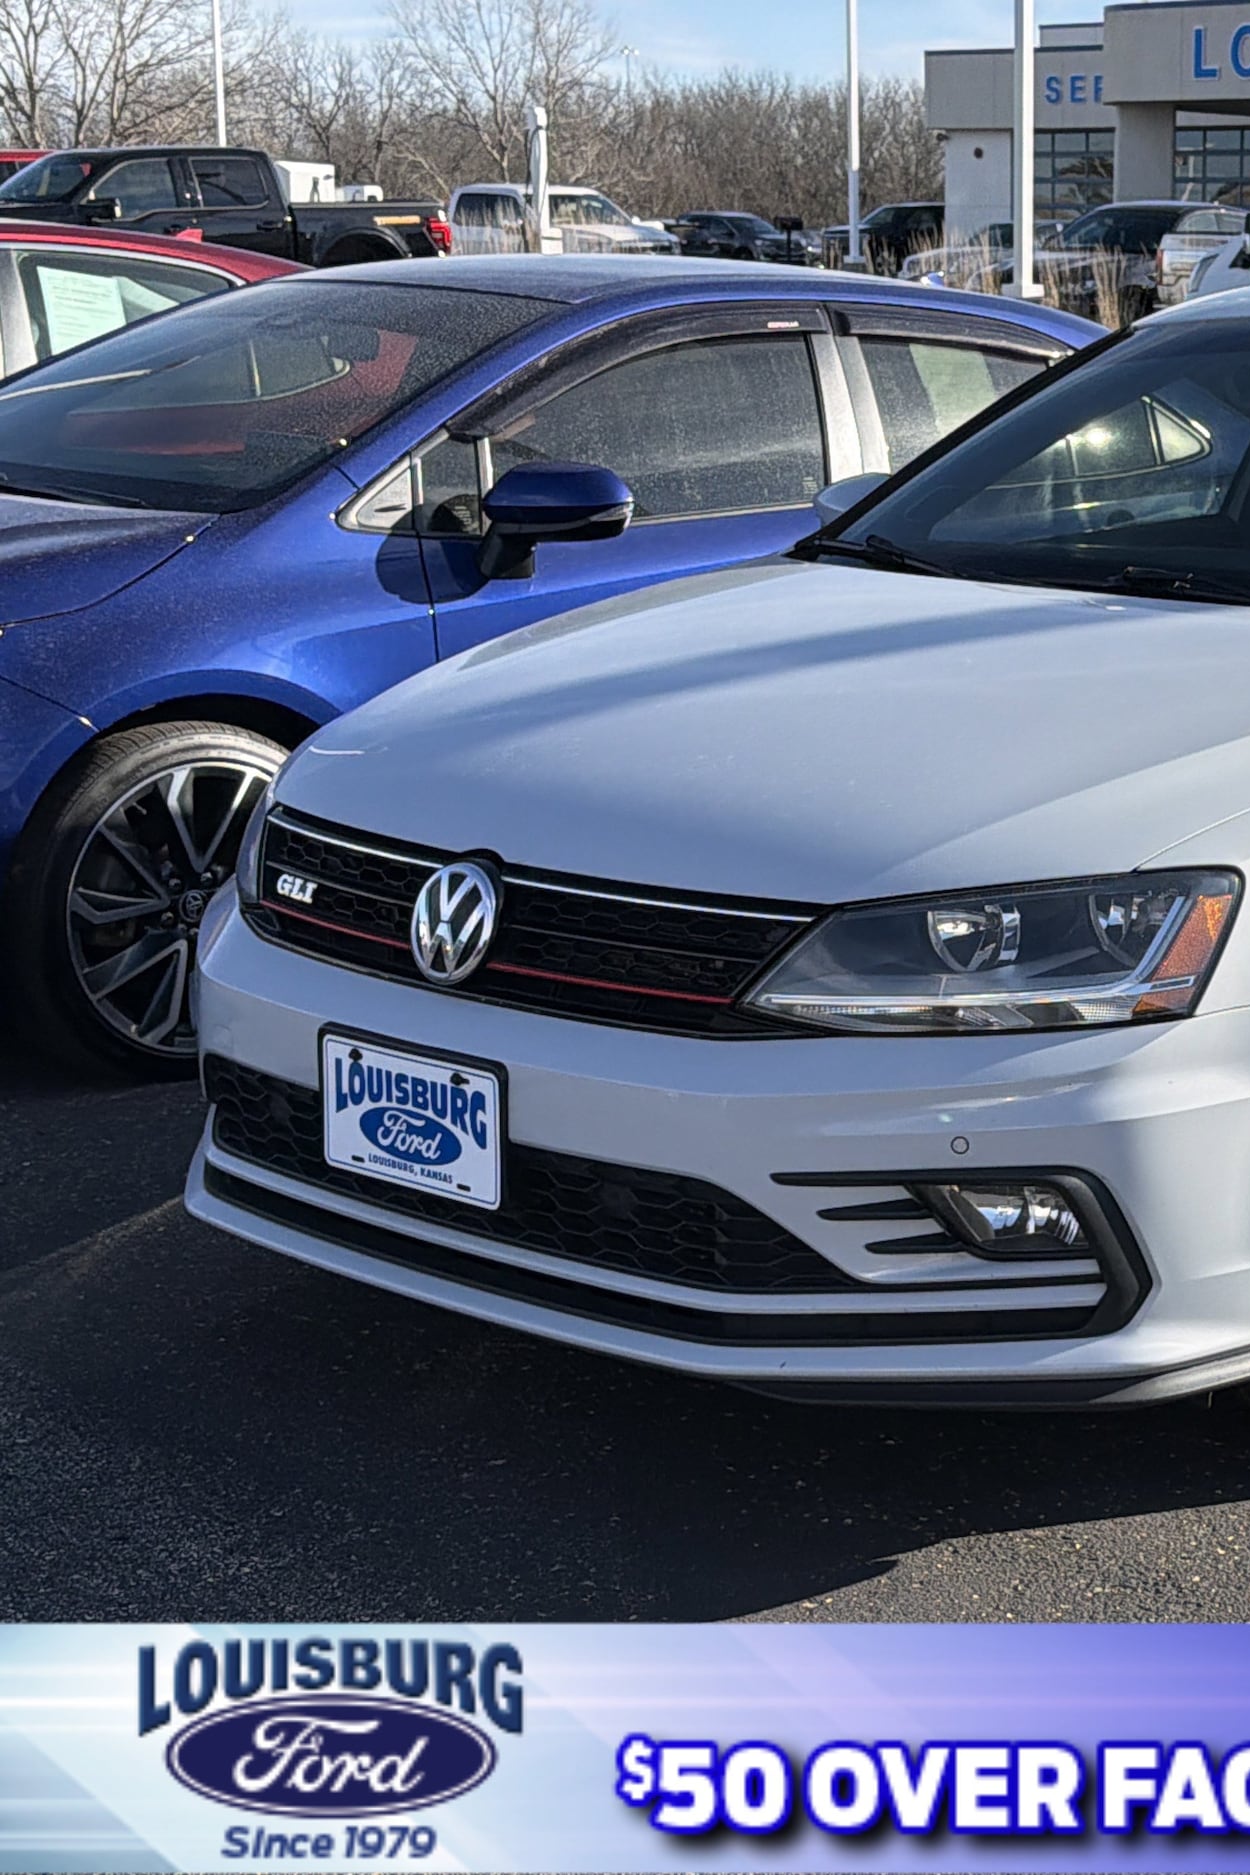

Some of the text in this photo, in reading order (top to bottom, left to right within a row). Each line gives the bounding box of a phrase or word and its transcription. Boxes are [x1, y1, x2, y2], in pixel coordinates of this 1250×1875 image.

[276, 873, 318, 905] GLI
[334, 1057, 488, 1150] LOUISBURG
[377, 1110, 443, 1160] Ford
[368, 1152, 453, 1184] LOUISBURG, KANSAS
